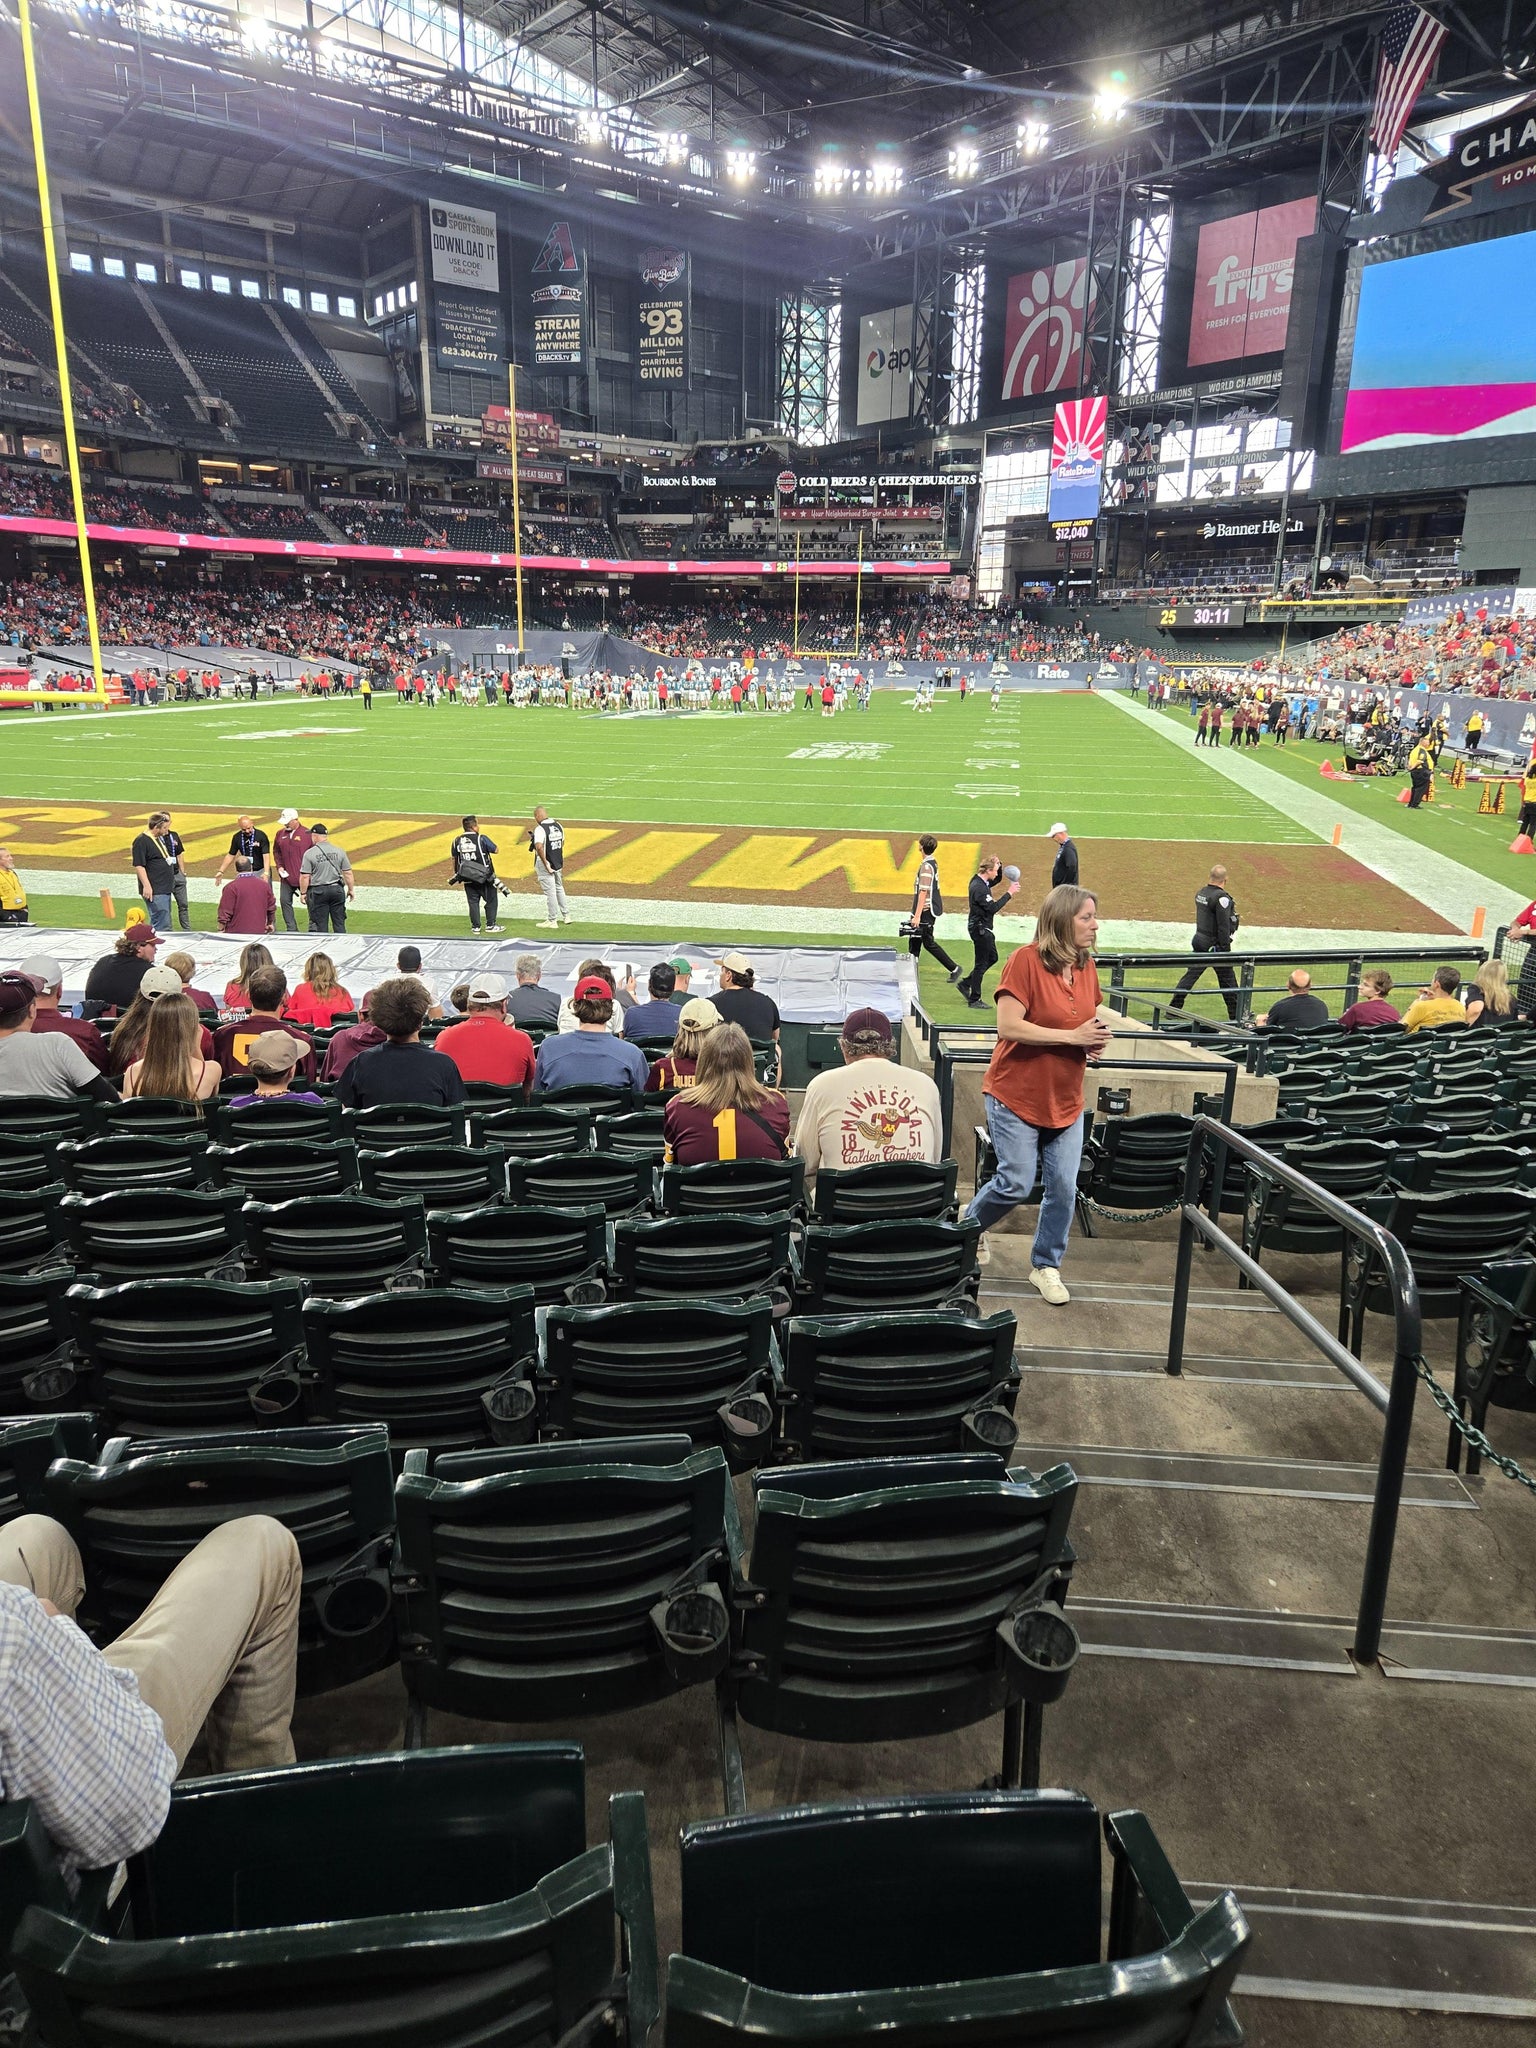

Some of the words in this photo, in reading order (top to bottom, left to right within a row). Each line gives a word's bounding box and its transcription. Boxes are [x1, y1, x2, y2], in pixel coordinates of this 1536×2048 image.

[448, 211, 476, 223] CAESARS
[448, 220, 495, 238] SPORTSBOOK
[433, 233, 484, 258] DOWNLOAD
[487, 244, 496, 260] IT
[449, 258, 461, 266] USE
[1256, 260, 1291, 274] STORES
[453, 266, 480, 277] DBACKS
[643, 269, 659, 282] Give
[658, 267, 680, 282] Back
[439, 300, 458, 309] Report
[459, 303, 474, 312] Guest
[475, 306, 497, 316] Conduct
[640, 301, 683, 309] CELEBRATING
[464, 312, 471, 320] by
[640, 309, 683, 336] $93
[1206, 318, 1229, 330] FRESH
[1231, 313, 1247, 325] FOR
[1250, 304, 1290, 320] EVERYONE
[534, 318, 580, 331] STREAM
[453, 332, 486, 343] LOCATION
[536, 332, 553, 341] ANY
[555, 331, 581, 340] GAME
[640, 337, 683, 348] MILLION
[442, 346, 498, 361] 623.304.0777
[536, 342, 581, 351] ANYWHERE
[640, 358, 683, 366] CHARITABLE
[640, 366, 683, 379] GIVING
[1208, 379, 1234, 393] WORLD
[1235, 372, 1283, 389] CHAMPIONS
[1119, 398, 1128, 407] NL
[1150, 387, 1193, 402] CHAMPIONS
[1207, 458, 1218, 467] NL
[1219, 452, 1267, 466] CHAMPIONS
[538, 471, 554, 480] SEATS
[1127, 467, 1145, 477] WILD
[1147, 464, 1167, 474] CARD
[682, 476, 689, 486] &
[800, 476, 828, 487] COLD
[831, 476, 867, 487] BEERS
[869, 476, 877, 486] &
[878, 474, 977, 486] CHEESEBURGERS
[811, 509, 824, 518] Your
[826, 509, 861, 518] Neighborhood
[863, 508, 882, 518] Burger
[883, 508, 897, 517] Joint
[1055, 526, 1088, 541] $12,040
[1217, 523, 1260, 537] Banner
[777, 562, 788, 572] 25
[1160, 609, 1177, 625] 25
[1194, 608, 1230, 624] 30:11
[829, 662, 859, 677] Rate
[1037, 664, 1069, 679] Rate
[841, 1089, 922, 1132] MINNESOTA
[712, 1108, 737, 1161] 1
[842, 1133, 857, 1151] 18
[909, 1131, 921, 1147] 51
[841, 1148, 880, 1165] Golden
[883, 1145, 926, 1162] Gophers
